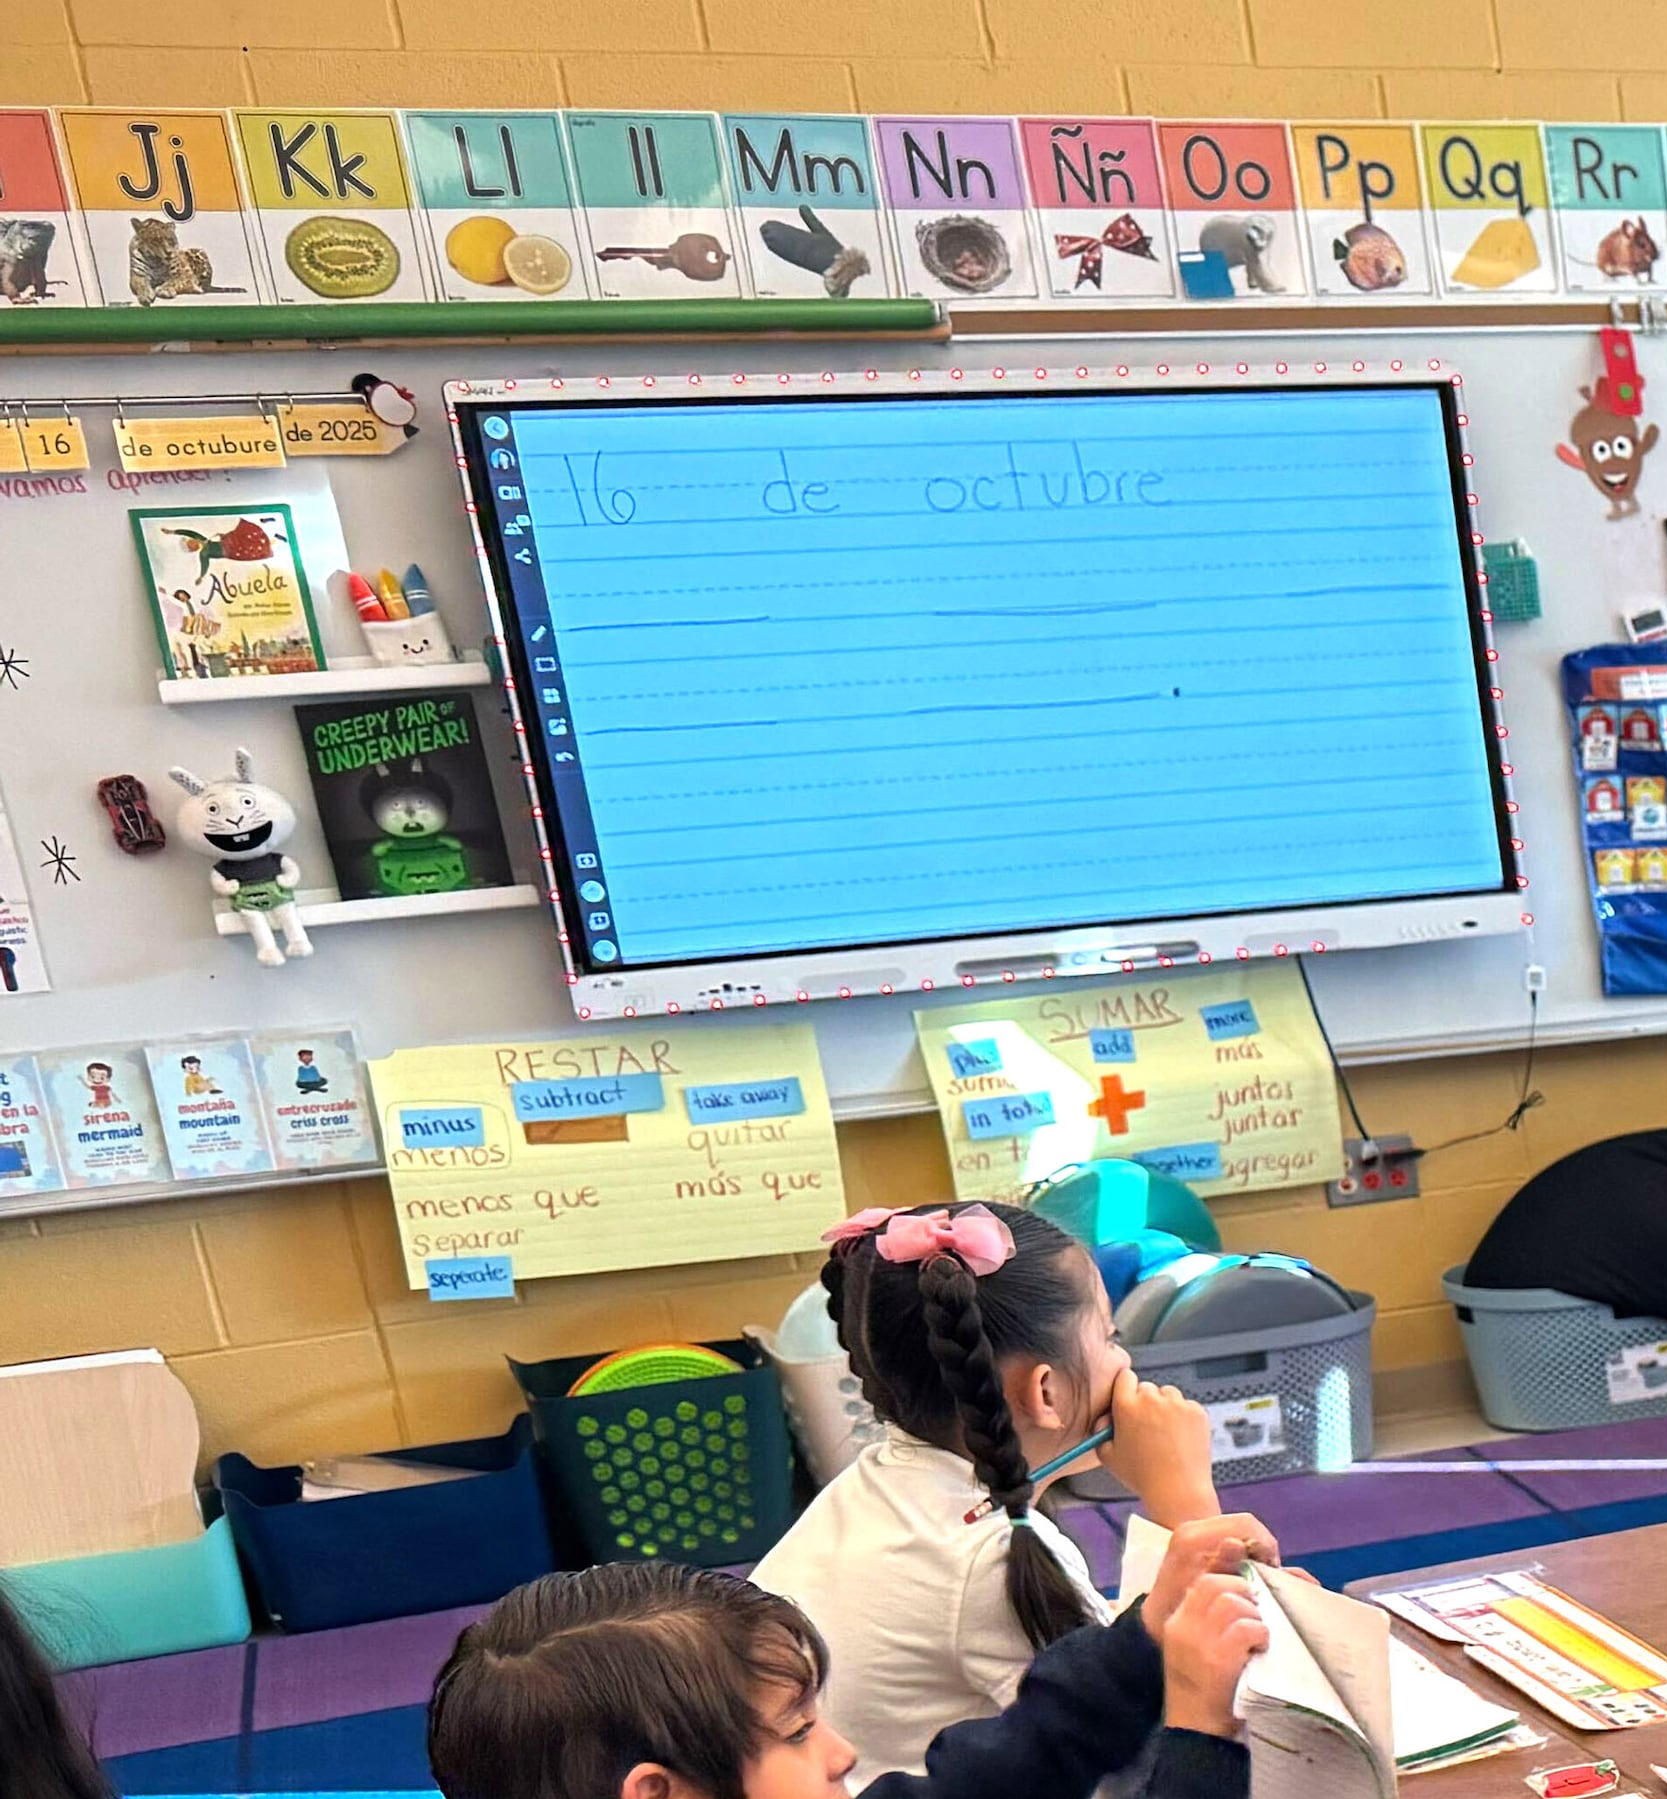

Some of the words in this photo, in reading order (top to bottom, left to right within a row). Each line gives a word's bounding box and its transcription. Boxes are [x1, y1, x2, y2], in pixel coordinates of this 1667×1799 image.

[116, 122, 195, 223] Jj
[269, 121, 376, 200] Kk
[452, 124, 524, 200] Ll
[733, 126, 866, 196] Mm
[902, 129, 997, 201] Nn
[1050, 126, 1136, 204] Ññ
[1183, 135, 1271, 201] Oo
[1316, 134, 1396, 223] Pp
[1438, 135, 1534, 218] Qq
[1571, 138, 1640, 200] Rr
[41, 433, 71, 456] 16
[121, 442, 153, 459] de
[286, 426, 313, 444] de
[317, 419, 378, 443] 2025
[562, 452, 638, 528] 16
[762, 448, 841, 517] de
[926, 440, 1172, 514] octubre
[201, 563, 289, 605] Abuela
[314, 709, 390, 748] CREEPY
[395, 700, 440, 730] PAIR
[317, 717, 471, 774] UNDERWEAR!
[1038, 988, 1174, 1037] SUMAR
[494, 1039, 682, 1087] RESTAR
[83, 1110, 131, 1126] sirena
[518, 1079, 629, 1112] subtract
[1209, 1074, 1295, 1121] juntos
[77, 1124, 144, 1143] mermaid
[178, 1114, 241, 1130] mountain
[290, 1115, 319, 1130] criss
[320, 1114, 350, 1128] cross
[403, 1114, 477, 1137] minus
[687, 1117, 793, 1169] quitar
[1221, 1105, 1304, 1145] juntar
[391, 1142, 506, 1168] menos
[405, 1191, 513, 1221] menos
[534, 1185, 601, 1220] que
[675, 1170, 742, 1200] más
[761, 1168, 823, 1201] que
